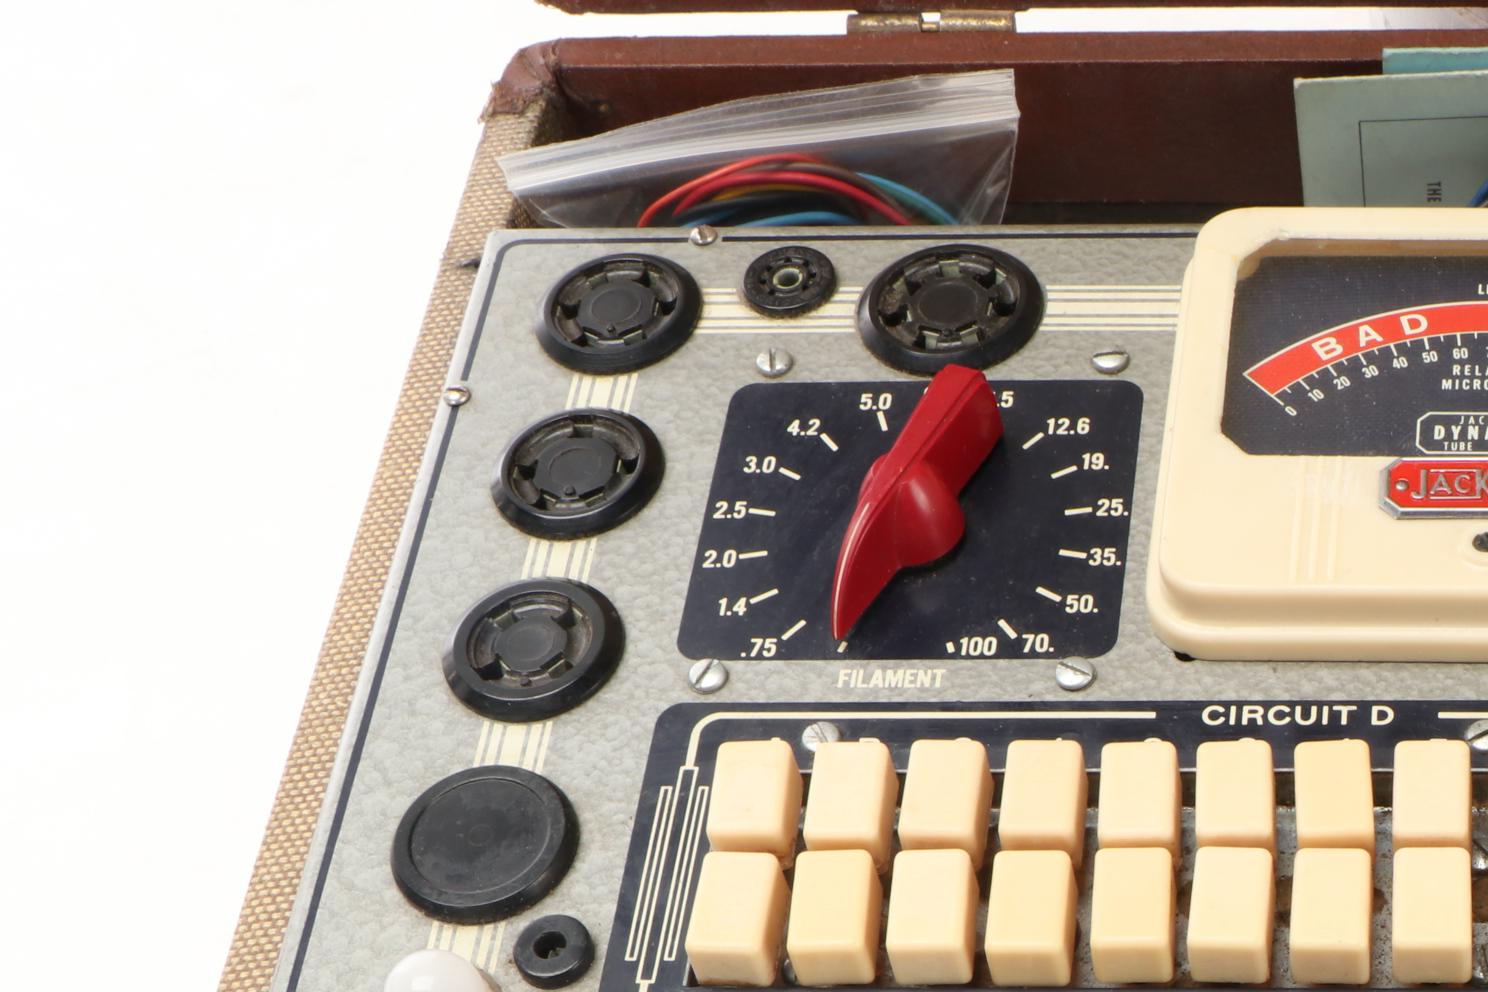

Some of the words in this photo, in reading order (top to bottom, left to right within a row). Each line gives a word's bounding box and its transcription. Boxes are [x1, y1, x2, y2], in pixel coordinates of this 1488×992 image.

[1426, 182, 1442, 202] THE
[1311, 312, 1430, 362] BAD
[1422, 350, 1438, 364] 50
[1452, 346, 1469, 360] 60
[1362, 364, 1380, 379] 30
[1392, 355, 1409, 370] 40
[1333, 375, 1351, 391] 20
[860, 393, 892, 410] 5.0
[1307, 388, 1325, 404] 10
[787, 419, 820, 437] 4.2
[1046, 417, 1090, 435] 12.6
[1443, 442, 1473, 452] TUBE
[743, 456, 776, 474] 3.0
[713, 501, 747, 519] 2.5
[702, 549, 737, 568] 2.0
[718, 598, 747, 617] 1.4
[740, 638, 777, 657] .75
[959, 636, 997, 656] 100
[836, 669, 946, 689] FILAMENT
[1201, 705, 1357, 726] CIRCUIT
[1371, 705, 1395, 726] D
